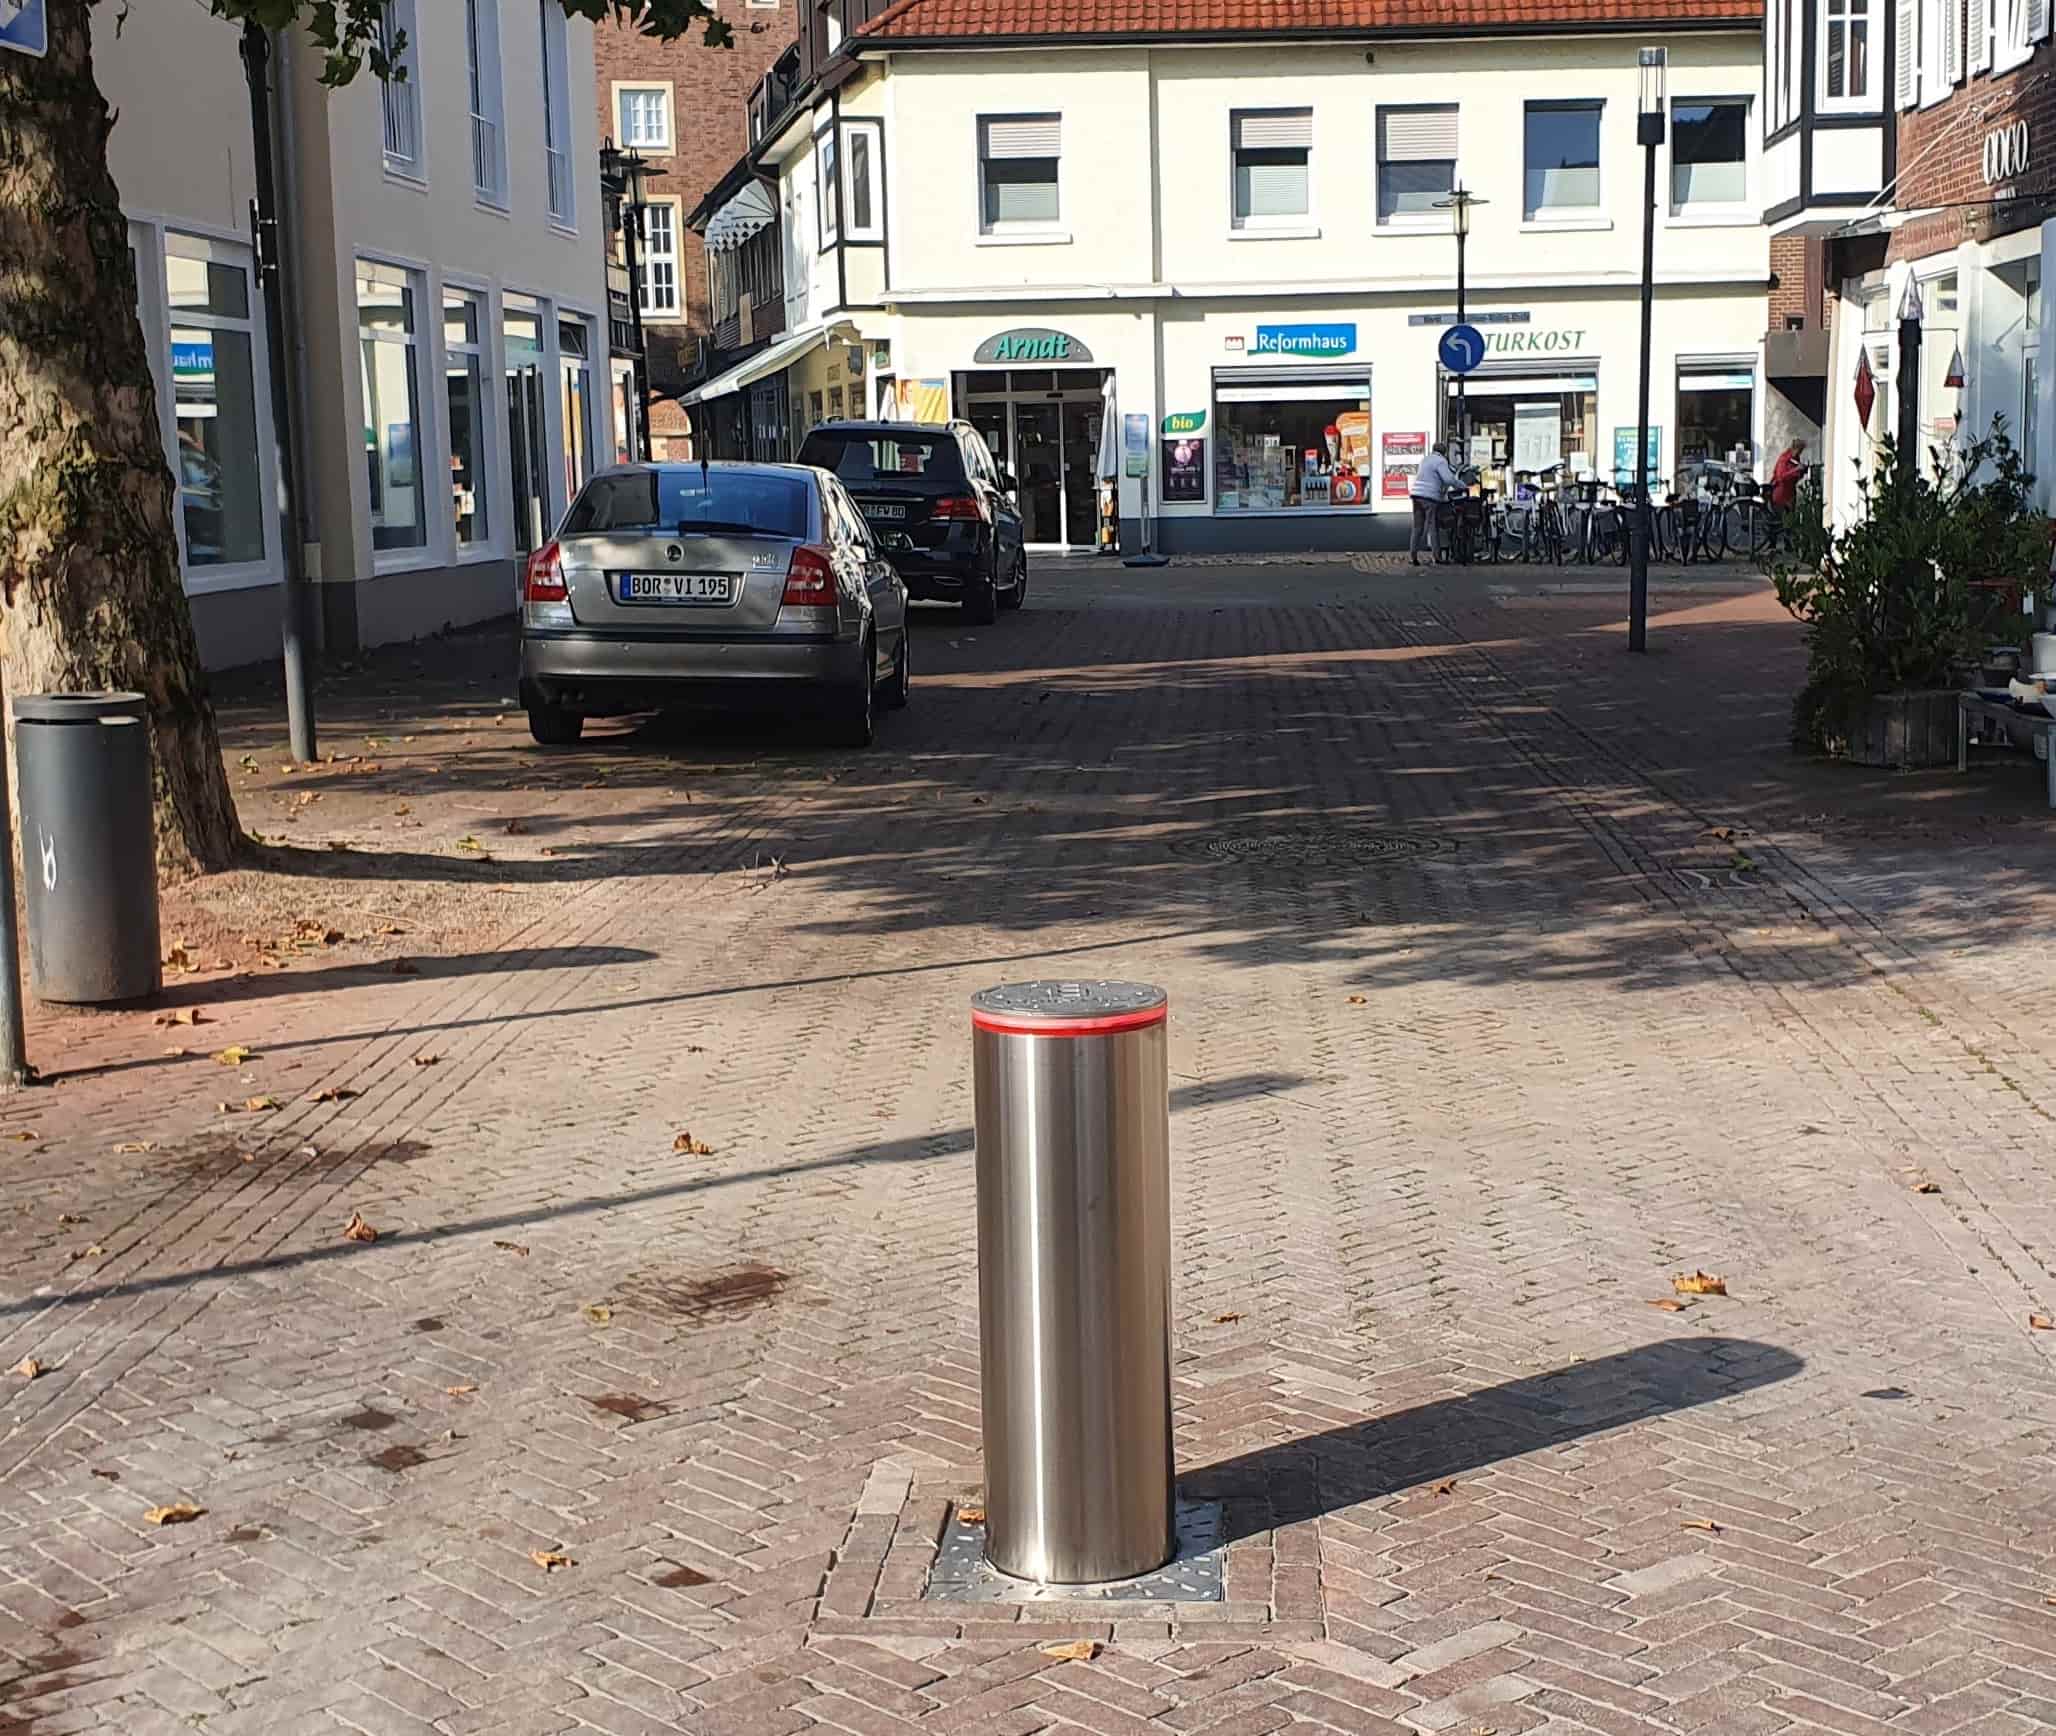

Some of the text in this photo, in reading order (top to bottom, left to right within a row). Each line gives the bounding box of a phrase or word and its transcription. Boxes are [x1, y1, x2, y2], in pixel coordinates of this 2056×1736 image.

[992, 334, 1071, 360] Arndt
[1258, 332, 1348, 353] Reformhaus
[1483, 329, 1587, 352] TURKOST
[1172, 416, 1194, 429] bio
[632, 577, 727, 596] BOR VI 195
